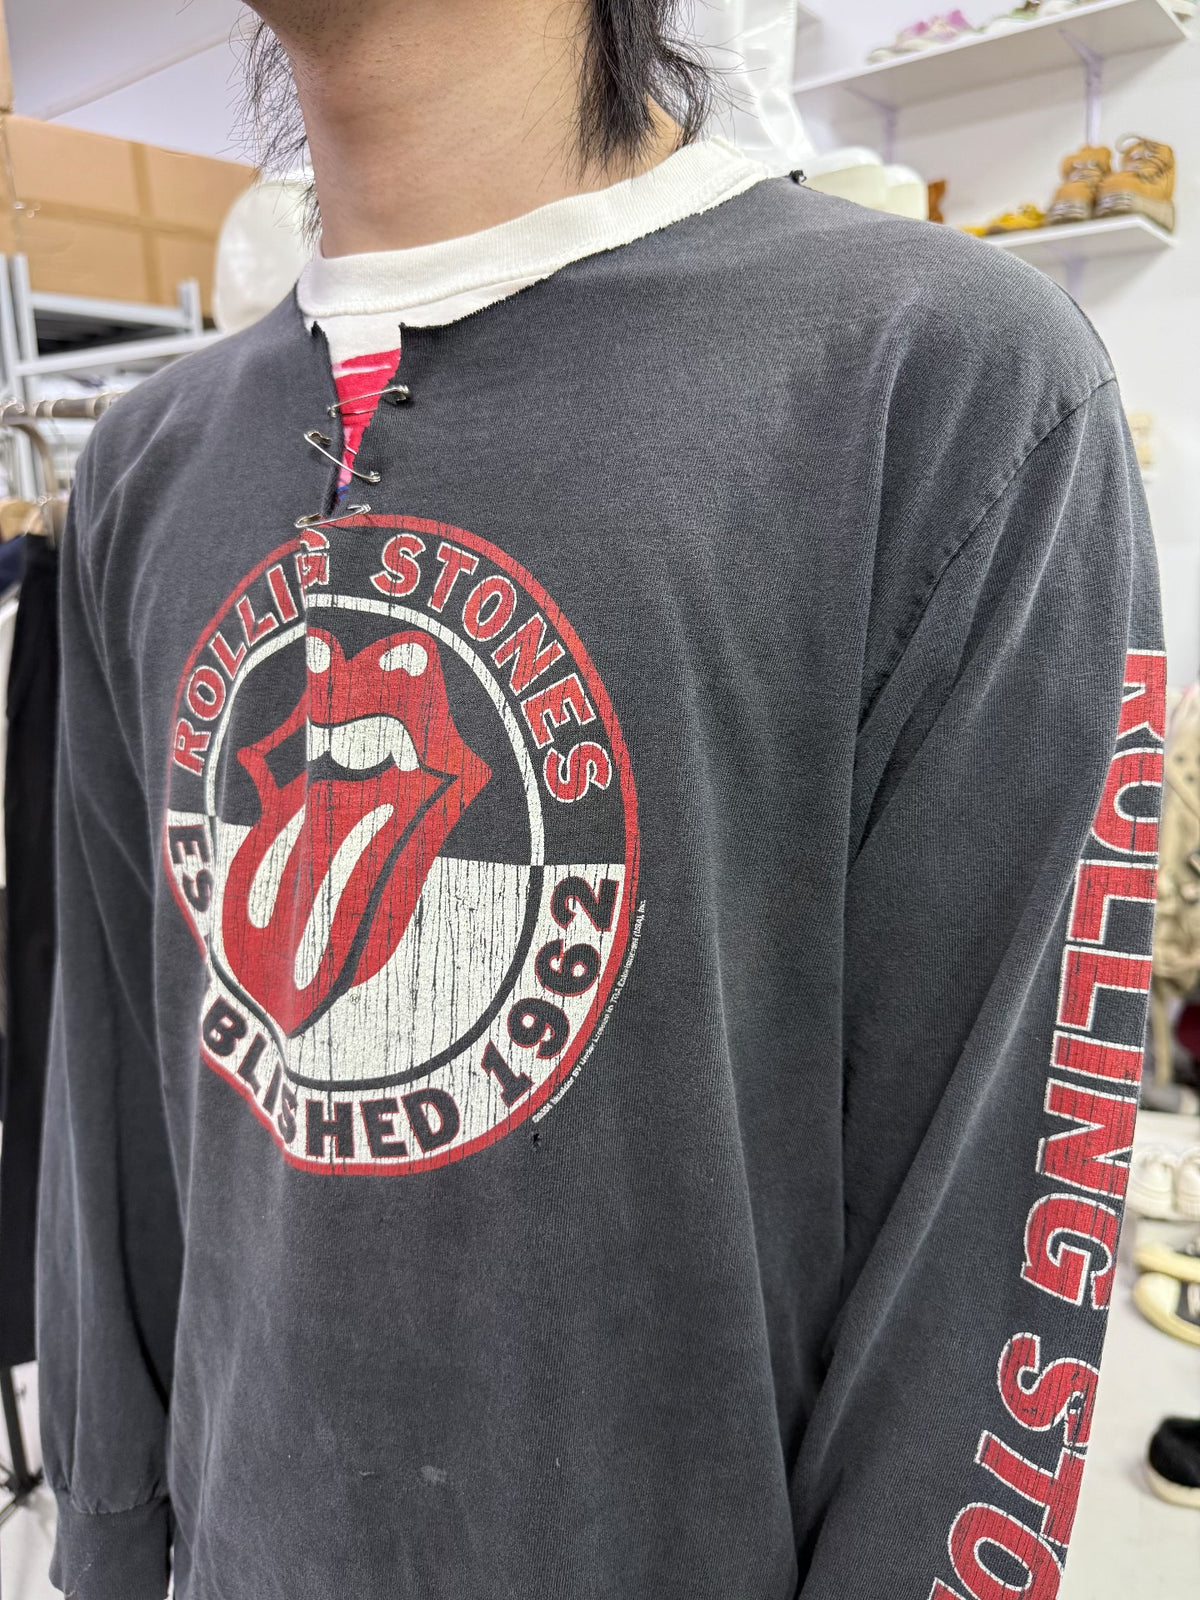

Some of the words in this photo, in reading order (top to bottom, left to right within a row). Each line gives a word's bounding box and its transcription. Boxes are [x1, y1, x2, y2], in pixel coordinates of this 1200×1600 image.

[172, 528, 330, 776] ROLLIG
[372, 532, 613, 804] STONES
[167, 824, 461, 1161] ESBLISHED
[482, 875, 621, 1109] 1962
[926, 1331, 1100, 1600] STO
